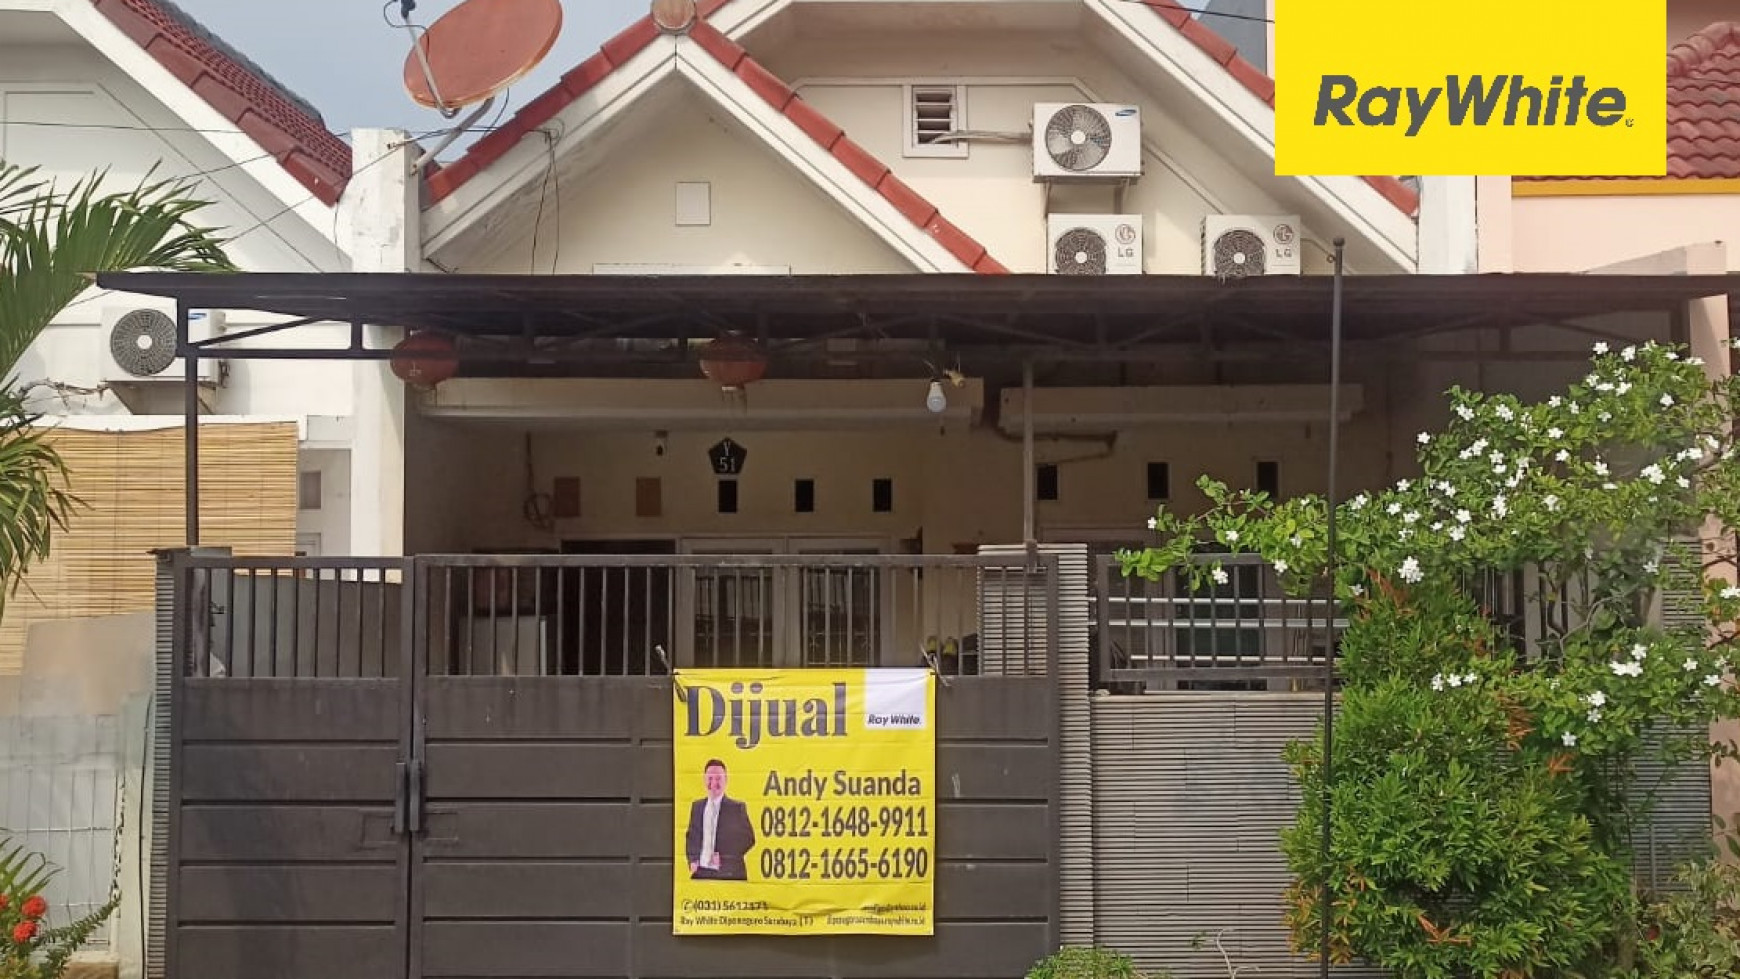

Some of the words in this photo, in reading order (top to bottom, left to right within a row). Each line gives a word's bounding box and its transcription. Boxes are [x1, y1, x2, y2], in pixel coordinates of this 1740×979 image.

[1117, 248, 1134, 258] LG
[1275, 248, 1292, 258] LG
[723, 440, 731, 456] Y
[720, 456, 735, 472] 51
[684, 682, 848, 749] Dijual
[868, 713, 889, 727] Ray
[763, 770, 827, 800] Andy
[833, 769, 921, 796] Suanda
[760, 806, 928, 838] 0812-1648-9911
[760, 848, 928, 879] 0812-1665-6190
